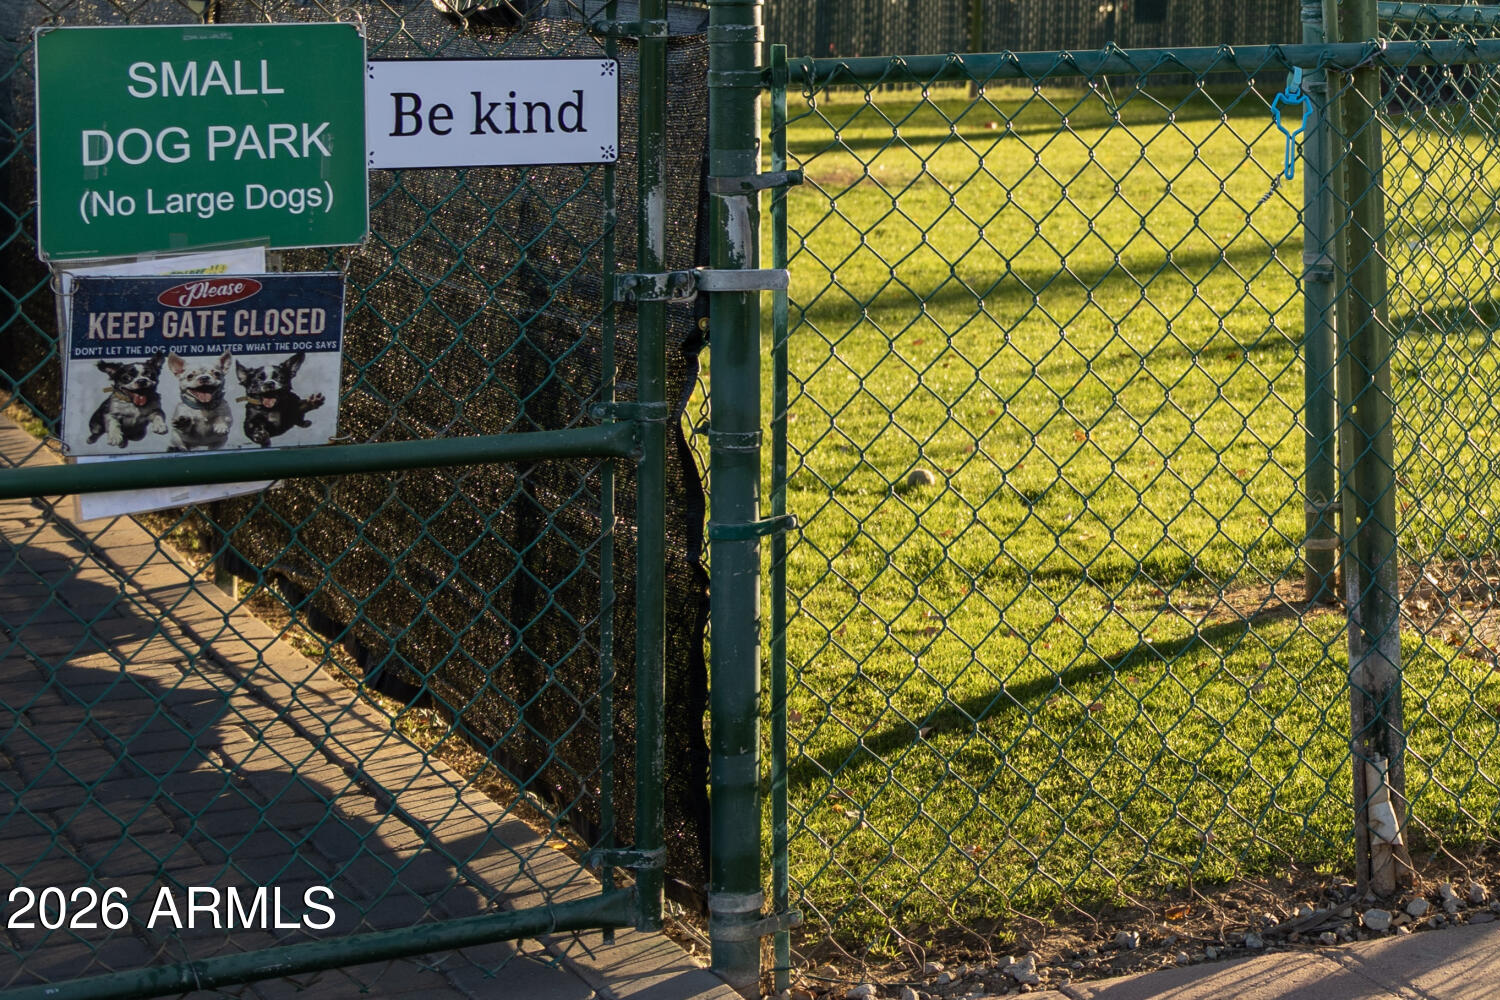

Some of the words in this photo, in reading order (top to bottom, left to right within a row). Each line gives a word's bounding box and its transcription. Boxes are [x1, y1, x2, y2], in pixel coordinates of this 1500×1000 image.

[128, 59, 285, 98] SMALL
[389, 92, 454, 137] Be
[469, 89, 588, 136] kind
[82, 126, 191, 167] DOG
[207, 121, 332, 162] PARK
[80, 190, 136, 224] (No
[147, 188, 235, 218] Large
[246, 181, 333, 214] Dogs)
[178, 281, 245, 307] Please
[88, 311, 155, 340] KEEP
[162, 310, 227, 338] GATE
[234, 307, 326, 337] CLOSED
[75, 347, 103, 356] DON'T
[106, 347, 122, 355] LET
[126, 346, 142, 355] THE
[145, 345, 166, 354] DOG
[169, 345, 188, 354] OUT
[190, 344, 204, 353] NO
[207, 343, 243, 353] MATTER
[246, 342, 271, 352] WHAT
[274, 342, 290, 351] THE
[293, 341, 313, 350] DOG
[315, 340, 337, 350] SAYS
